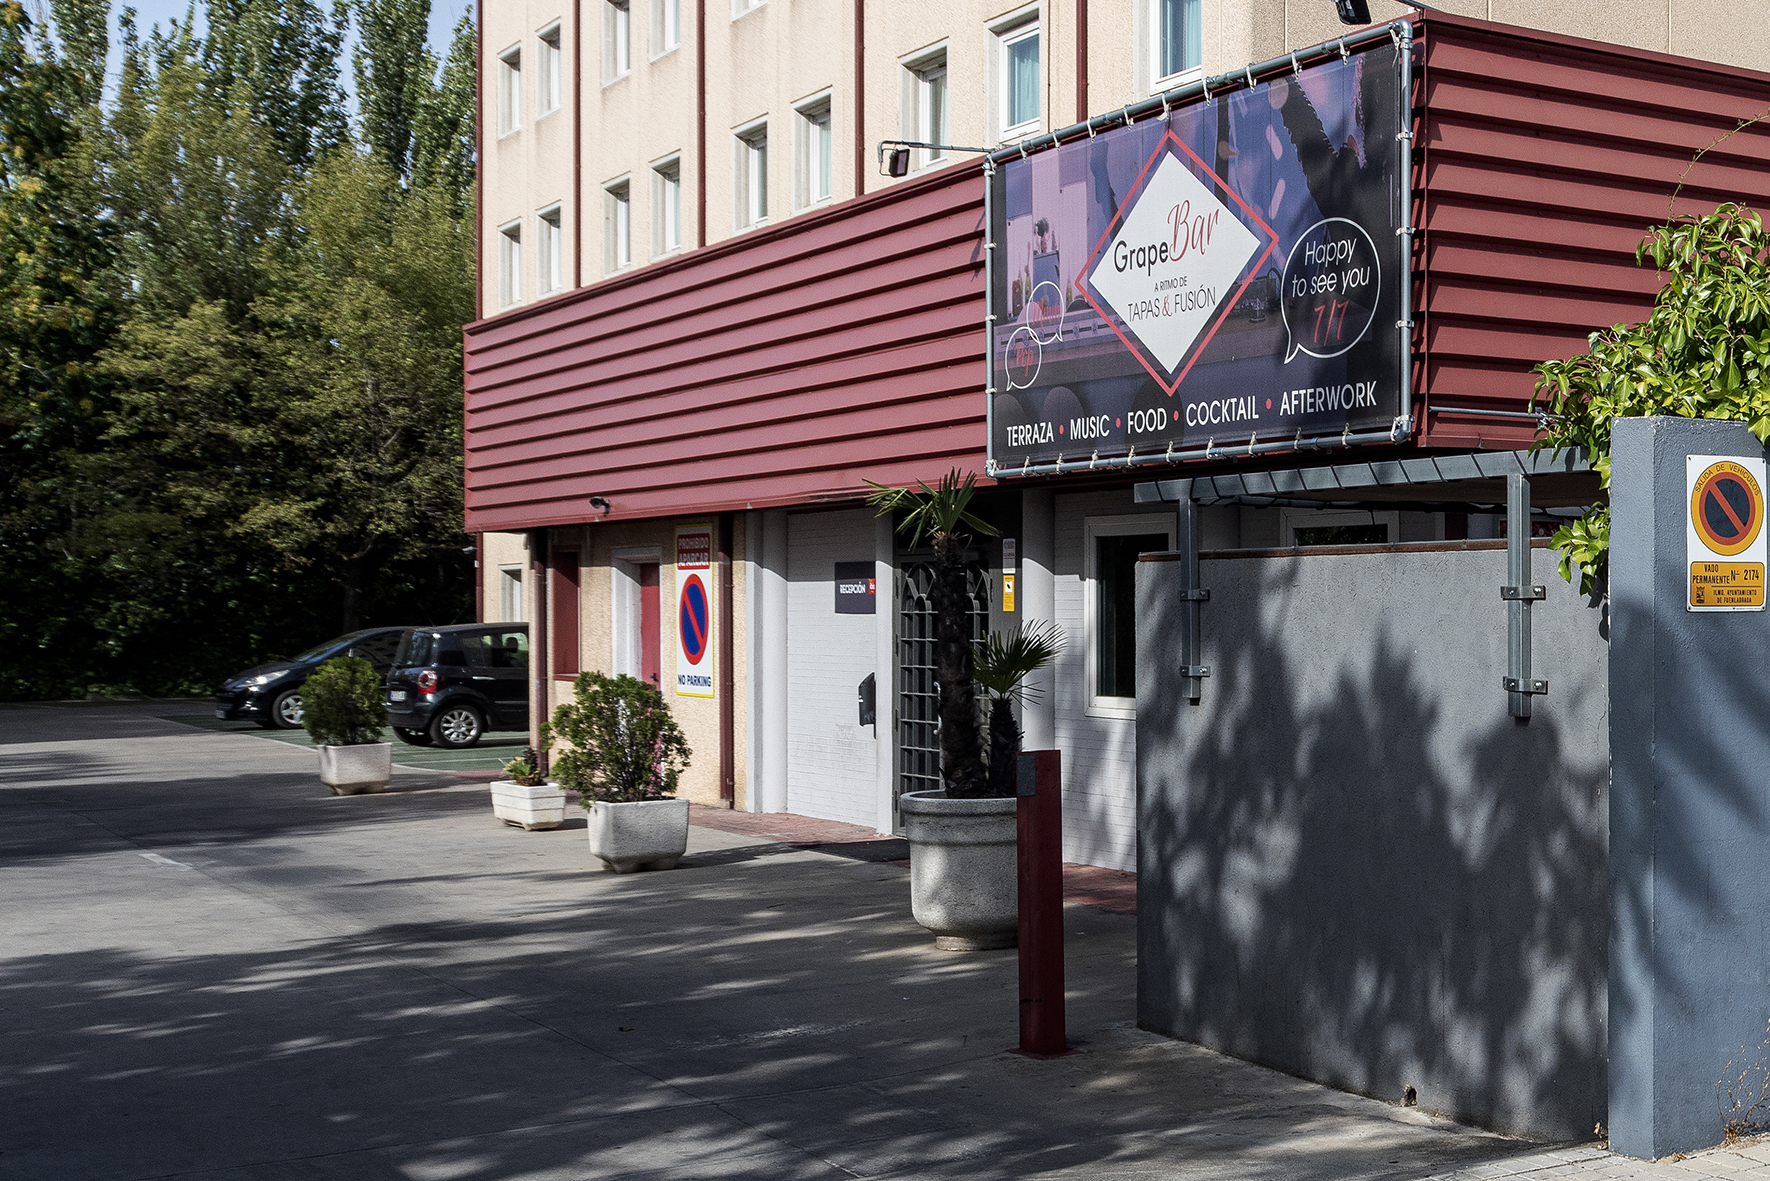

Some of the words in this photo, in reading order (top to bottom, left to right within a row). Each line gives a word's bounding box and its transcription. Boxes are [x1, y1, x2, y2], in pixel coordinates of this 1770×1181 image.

[1304, 238, 1357, 267] Happy
[1154, 282, 1159, 292] A
[1160, 278, 1178, 291] RITMO
[1179, 276, 1187, 287] DE
[1292, 274, 1307, 298] to
[1310, 272, 1337, 295] see
[1342, 266, 1370, 295] you
[1128, 298, 1160, 322] TAPAS
[1162, 294, 1173, 317] &
[1174, 284, 1216, 313] FUSIÓN
[1007, 422, 1054, 447] TERRAZA
[1070, 414, 1110, 440] MUSIC
[1127, 407, 1167, 434] FOOD
[1186, 395, 1259, 427] COCKTAIL
[1280, 380, 1377, 416] AFTERWORK
[1695, 469, 1713, 493] SALIDA
[1716, 464, 1725, 472] DE
[1729, 464, 1760, 496] VEHICULOS
[679, 552, 709, 567] APARCAR
[1704, 564, 1719, 573] VADO
[1744, 569, 1760, 581] 2174
[1692, 575, 1730, 584] PERMANENTE
[678, 674, 685, 685] NO
[687, 675, 711, 687] PARKING
